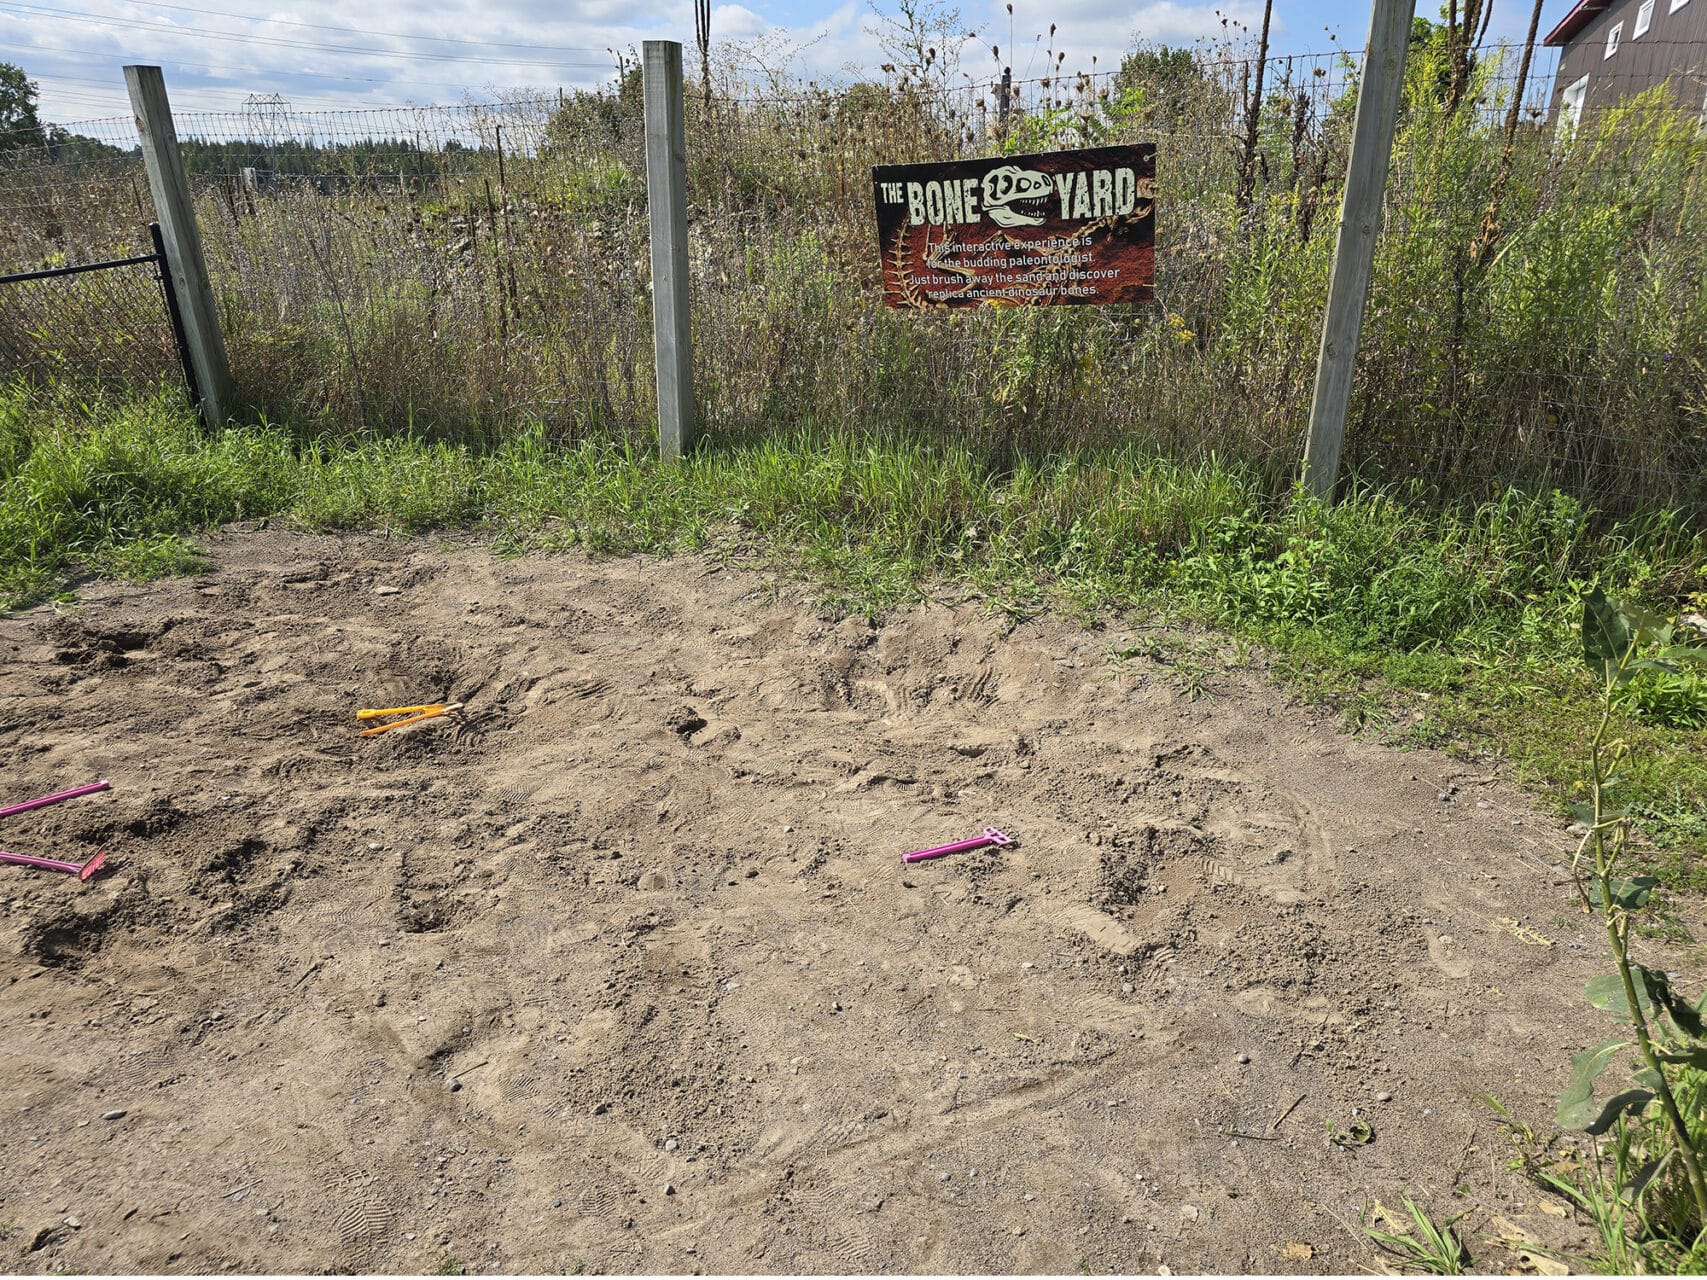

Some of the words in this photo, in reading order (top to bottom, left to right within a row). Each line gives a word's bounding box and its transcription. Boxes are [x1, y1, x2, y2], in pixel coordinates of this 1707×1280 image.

[881, 182, 904, 204] THE
[907, 178, 981, 226] BONE
[1055, 167, 1136, 220] YARD
[928, 242, 950, 253] This
[952, 241, 1013, 253] interactive
[1014, 237, 1079, 251] experience
[1081, 236, 1093, 246] is
[927, 259, 941, 268] for
[944, 258, 961, 268] the
[963, 257, 1007, 269] budding
[1009, 252, 1096, 268] paleontologist.
[909, 274, 931, 285] Just
[933, 273, 964, 284] brush
[965, 275, 993, 285] away
[995, 273, 1013, 282] the
[1015, 271, 1043, 282] sand
[1045, 270, 1066, 281] and
[1068, 269, 1120, 280] discover
[928, 290, 964, 301] replica
[966, 288, 1008, 298] ancient
[1008, 287, 1059, 297] dinosaur
[1060, 285, 1099, 295] bones.
